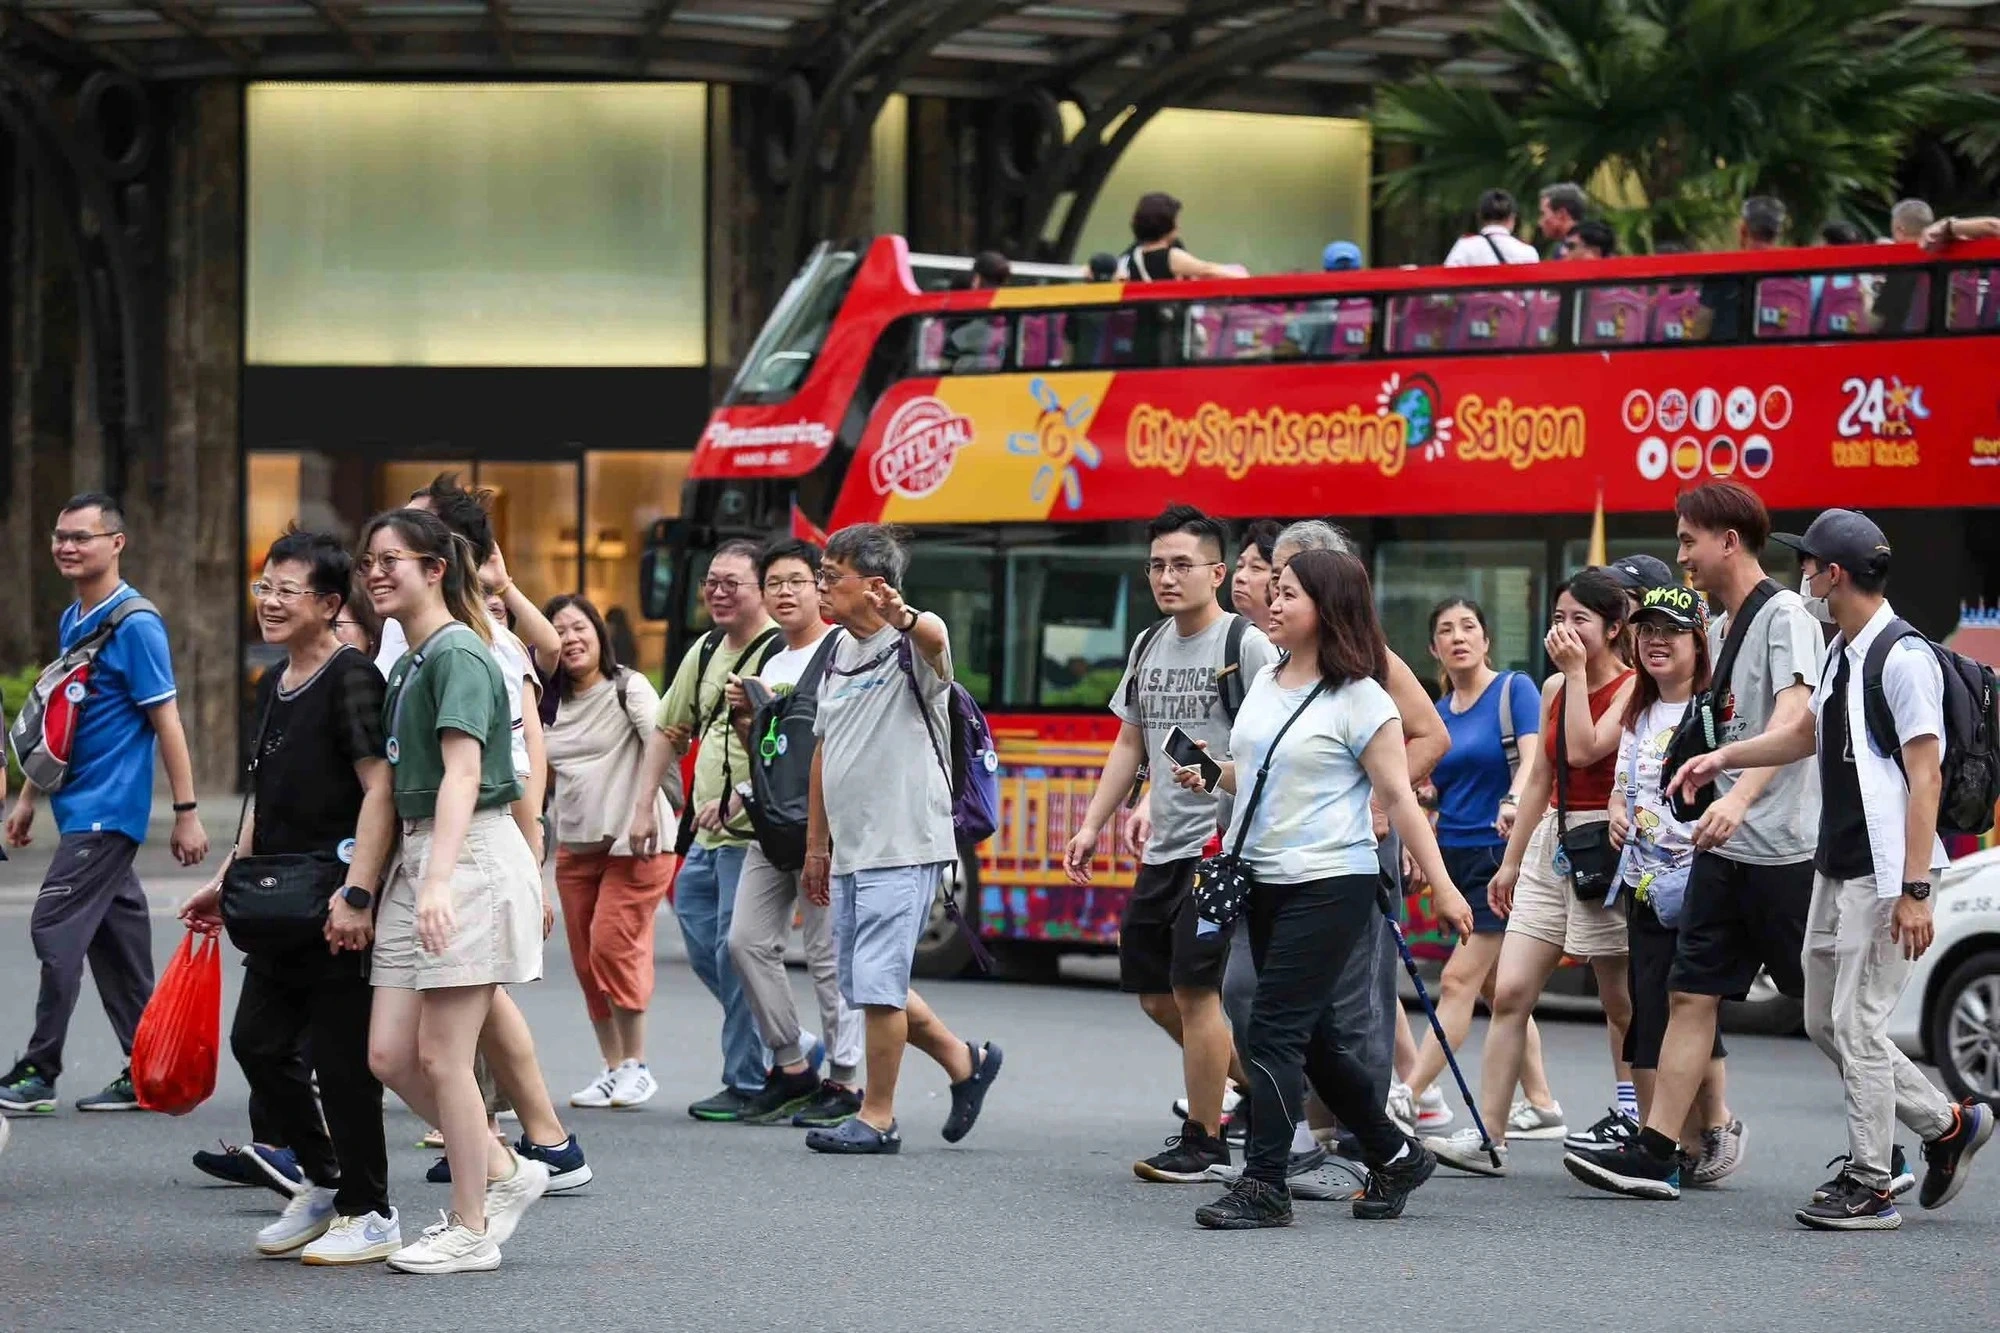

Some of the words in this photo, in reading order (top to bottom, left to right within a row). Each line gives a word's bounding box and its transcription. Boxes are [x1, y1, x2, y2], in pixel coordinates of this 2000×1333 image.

[1456, 393, 1585, 470] Saigon
[1839, 377, 1887, 437] 24
[879, 417, 973, 483] OFFICIAL
